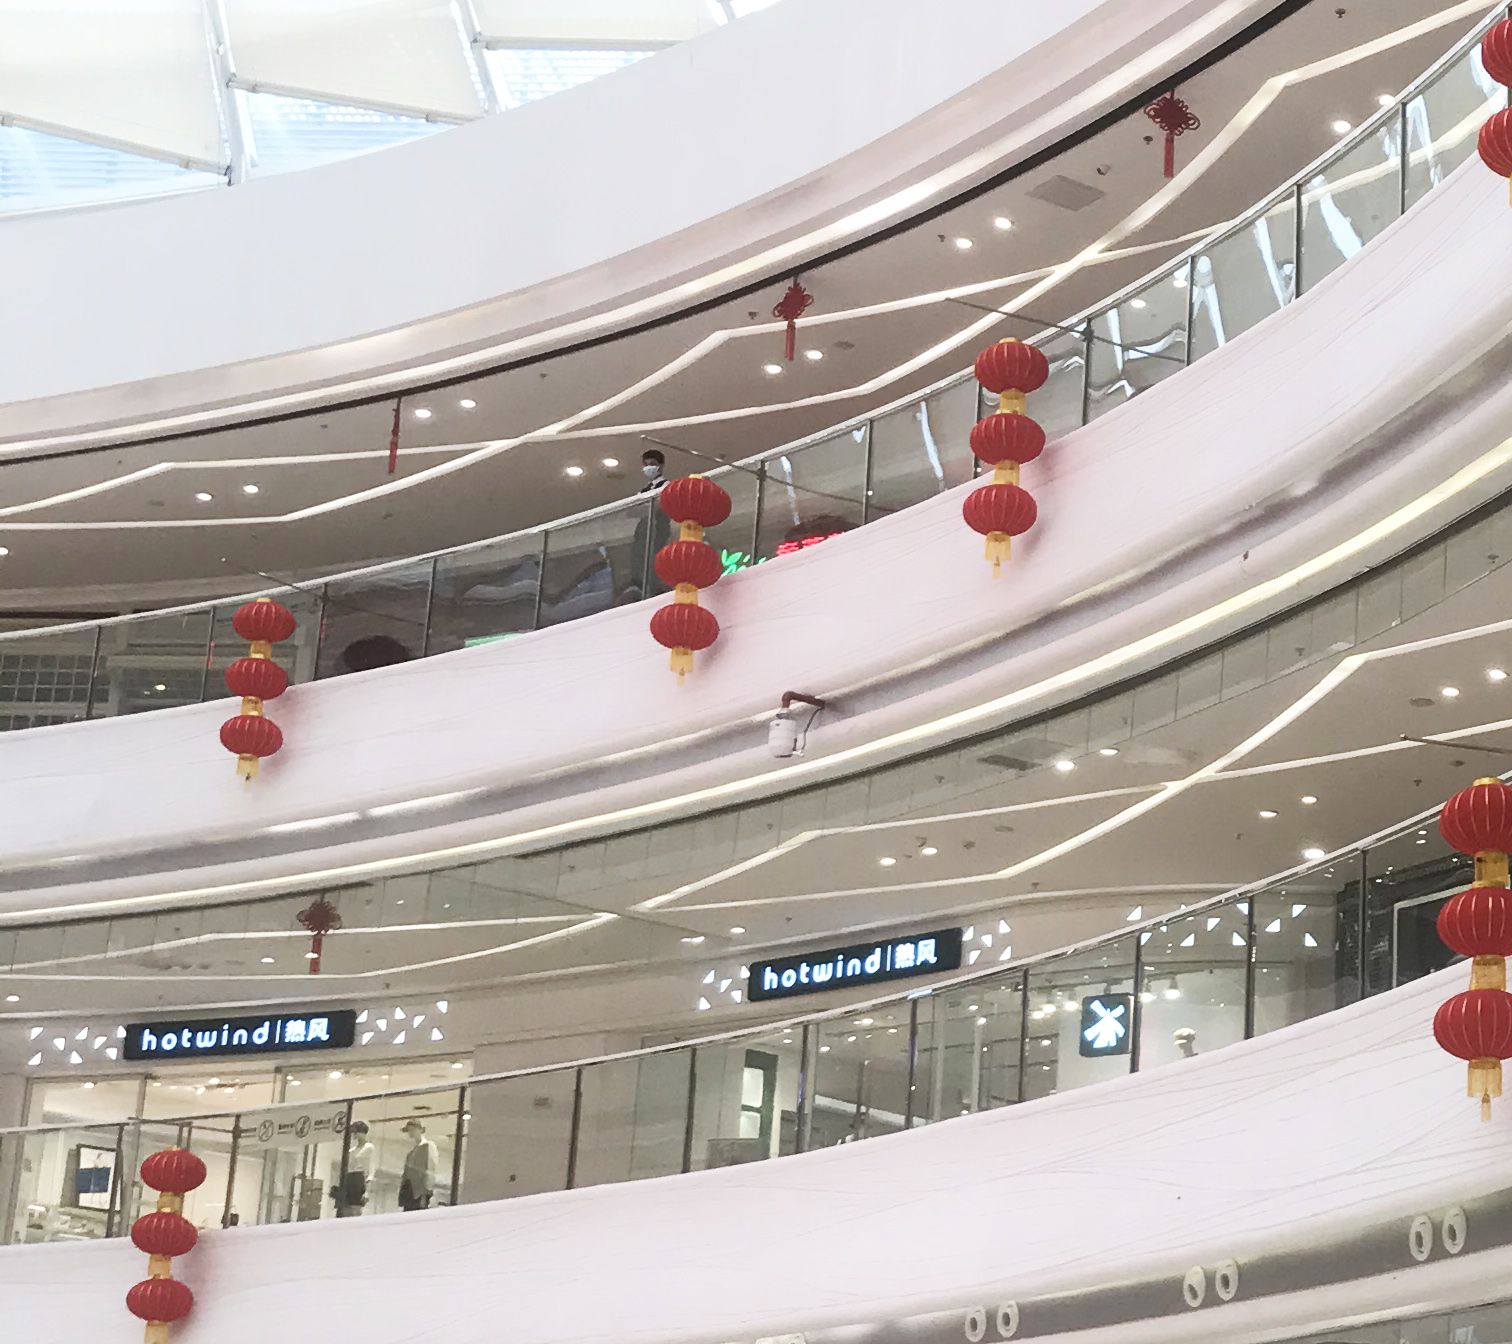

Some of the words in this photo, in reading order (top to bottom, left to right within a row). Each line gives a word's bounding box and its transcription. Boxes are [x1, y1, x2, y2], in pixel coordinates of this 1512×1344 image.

[763, 947, 882, 991] hotwind
[895, 938, 938, 969] 热风
[141, 1020, 271, 1051] hotwind
[284, 1017, 330, 1043] 热风
